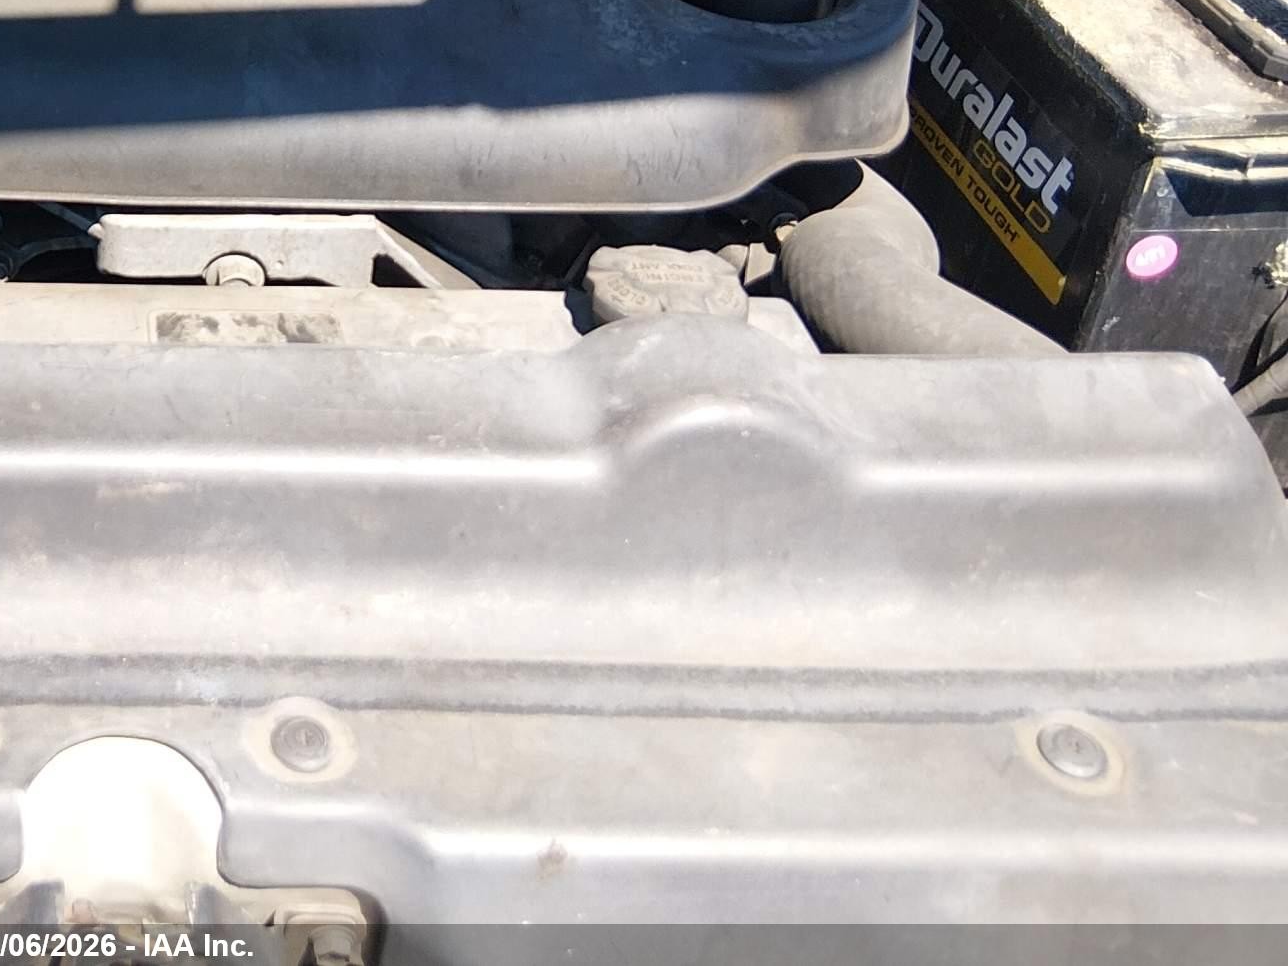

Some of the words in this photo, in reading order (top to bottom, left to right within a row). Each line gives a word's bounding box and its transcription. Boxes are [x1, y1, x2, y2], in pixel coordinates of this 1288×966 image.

[912, 4, 1073, 215] Duralast
[966, 176, 1020, 243] TOUGH
[972, 138, 1051, 234] GOLD
